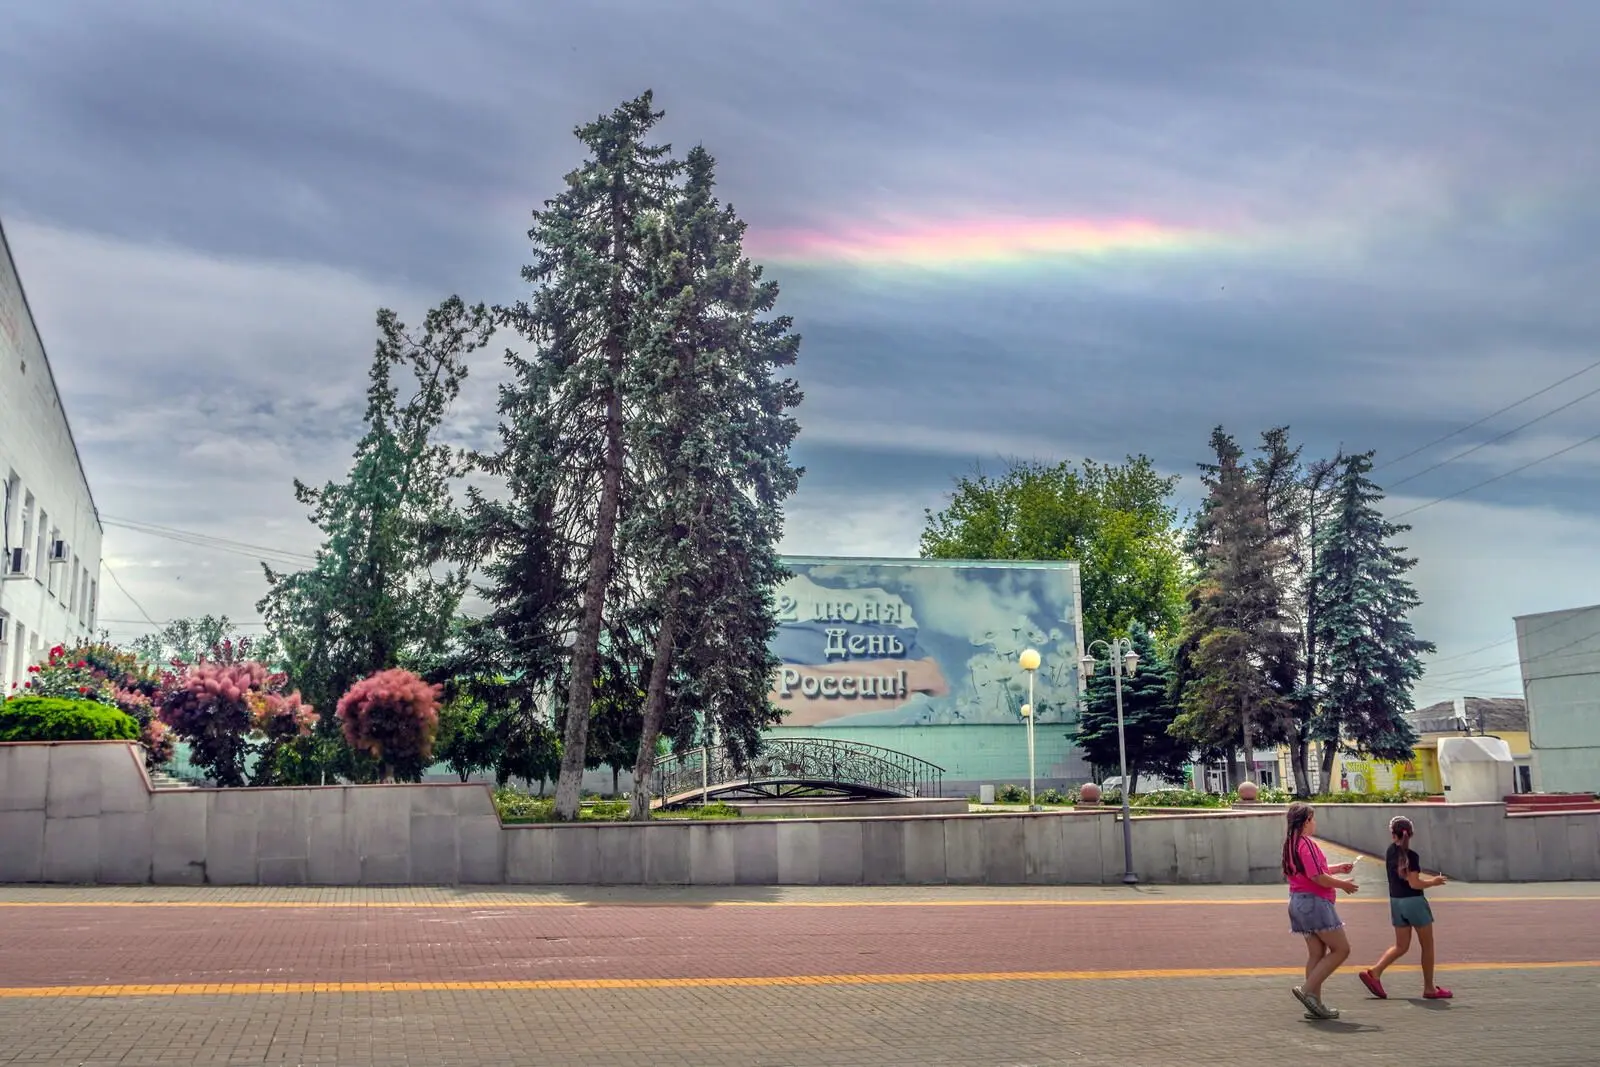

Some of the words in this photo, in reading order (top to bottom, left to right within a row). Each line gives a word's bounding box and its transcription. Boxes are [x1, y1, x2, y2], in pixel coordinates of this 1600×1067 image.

[779, 596, 798, 622] 2
[814, 601, 902, 622] июня
[823, 628, 905, 659] День
[780, 668, 907, 698] России!
